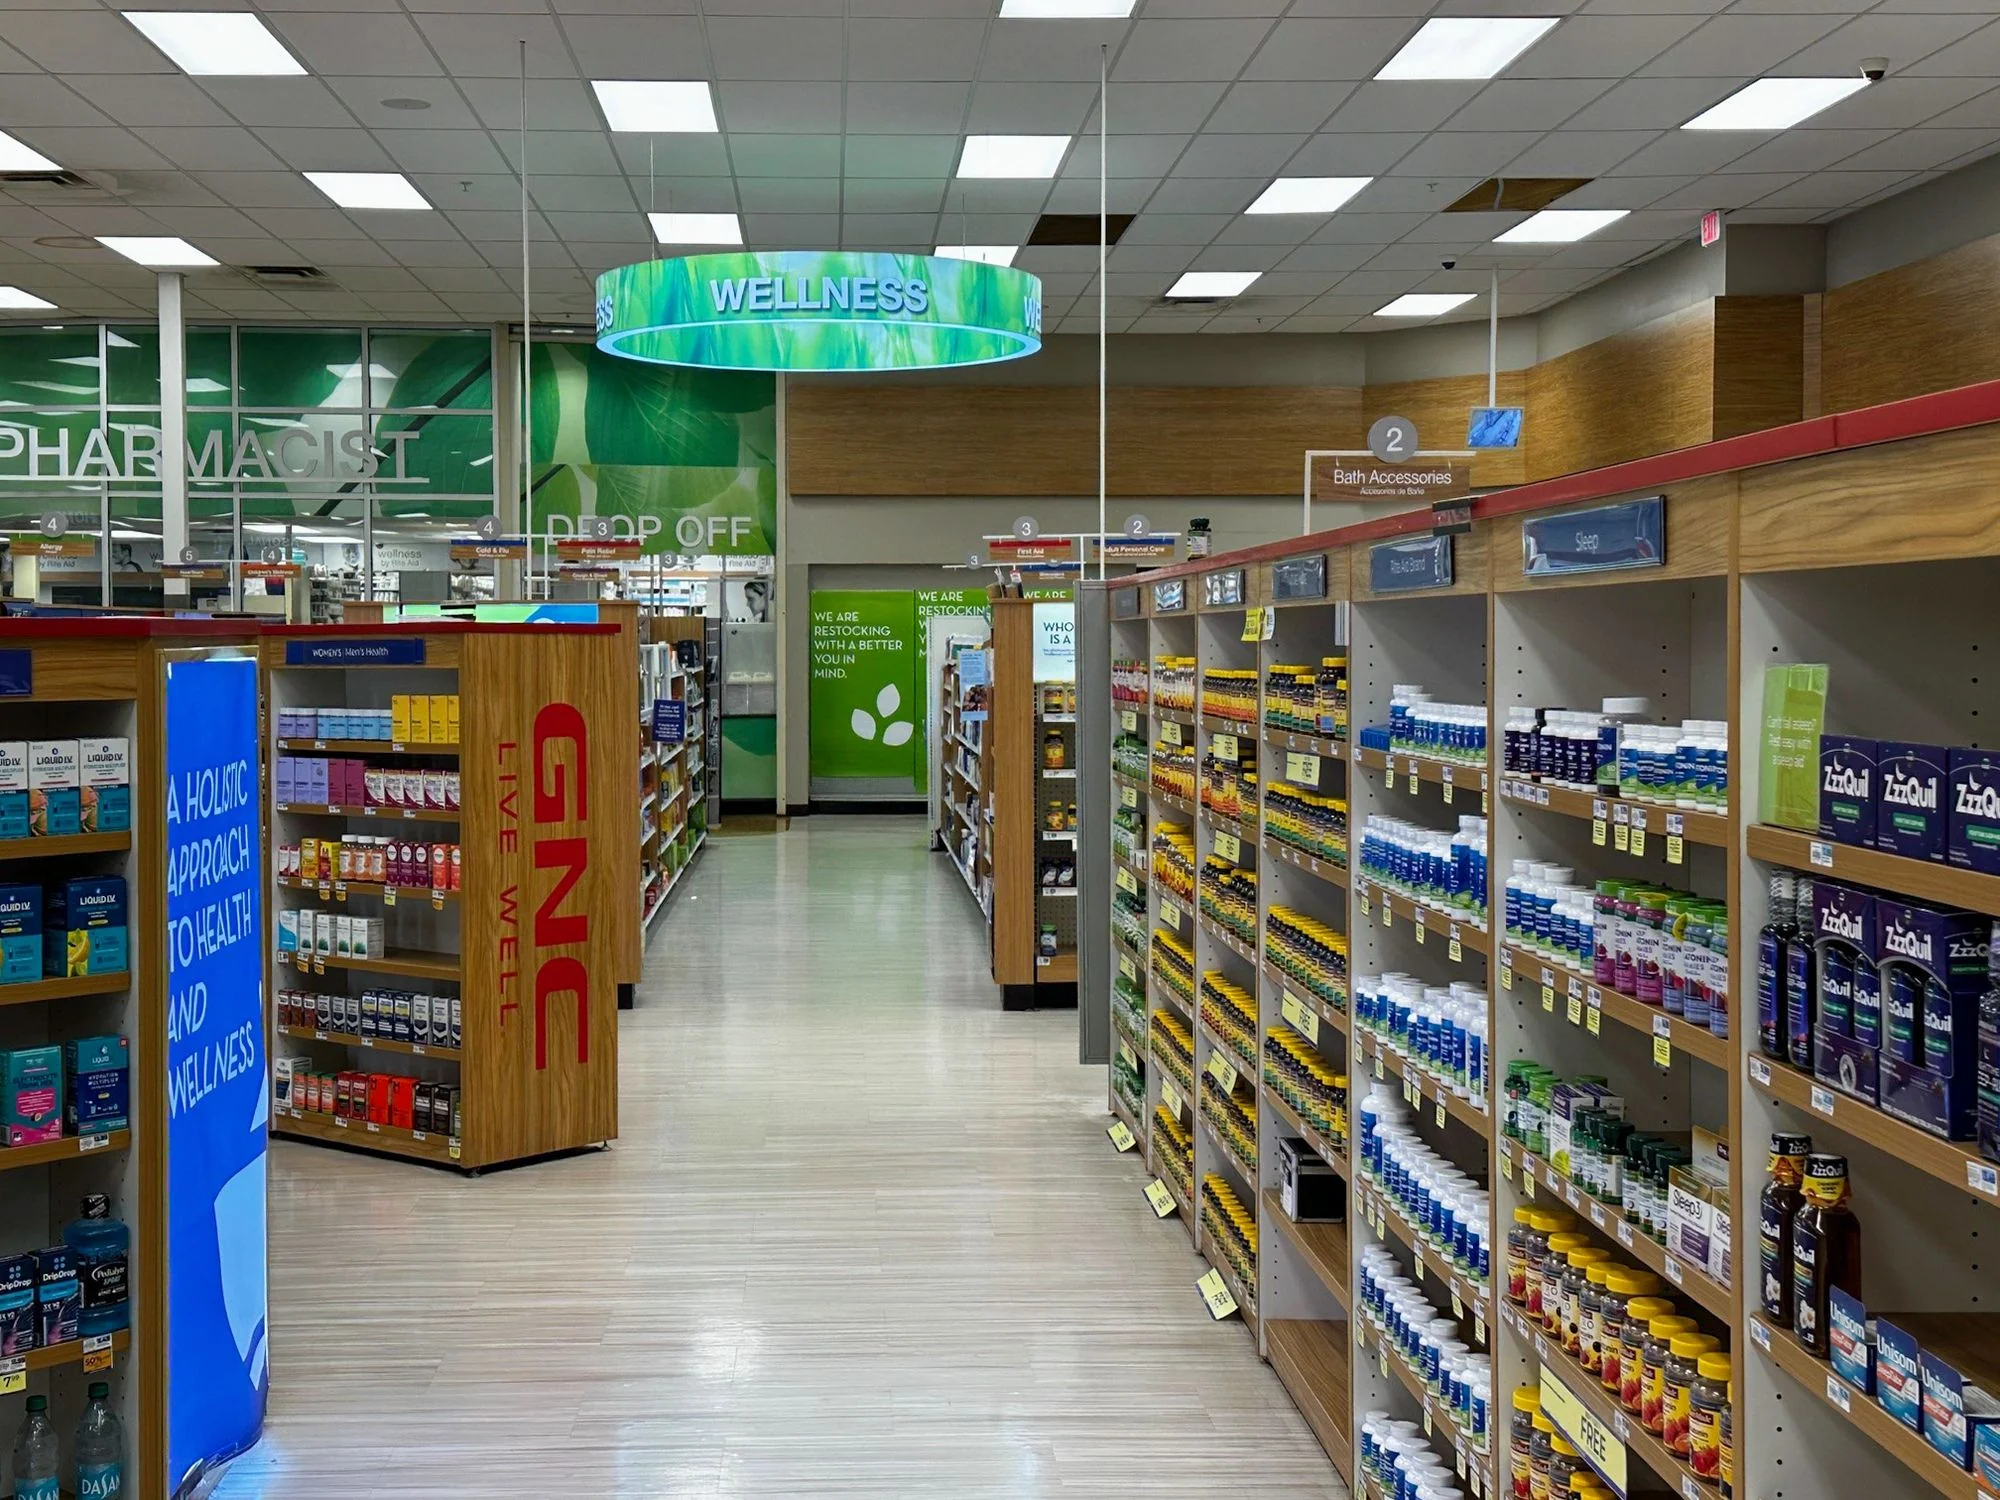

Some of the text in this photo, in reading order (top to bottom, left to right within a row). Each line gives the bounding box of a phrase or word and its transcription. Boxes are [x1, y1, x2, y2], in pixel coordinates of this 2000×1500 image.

[709, 277, 928, 313] WELLNESS
[1386, 427, 1403, 452] 2
[0, 428, 419, 479] PHARMACIST
[1334, 470, 1452, 485] Bath Accessories
[48, 518, 57, 531] 4
[483, 521, 493, 534] 4
[597, 521, 608, 537] 3
[675, 515, 751, 547] OFF
[1022, 522, 1031, 536] 3
[1133, 521, 1142, 534] 2
[1575, 531, 1599, 554] Sleep
[185, 551, 193, 560] 5
[268, 551, 275, 560] 4
[664, 554, 673, 565] 3
[970, 556, 978, 565] 3
[919, 591, 964, 601] WE ARE
[815, 612, 860, 622] WE ARE
[919, 605, 985, 616] RESTOCKIN
[815, 626, 890, 637] RESTOCKING
[1043, 622, 1075, 632] WHO
[814, 640, 903, 650] WITH A BETTER
[1050, 634, 1071, 644] IS A
[312, 648, 341, 657] WOMEN'S
[365, 647, 388, 656] Health
[815, 654, 855, 665] YOU IN
[814, 668, 847, 679] MIND.
[36, 756, 61, 765] LIQUID
[88, 754, 113, 762] LIQUID
[1824, 765, 1869, 798] ZzzQuil
[167, 759, 248, 824] A HOLISTIC
[499, 742, 518, 854] LIVE
[1884, 774, 1937, 809] ZzzQuil
[167, 824, 250, 897] APPROACH
[533, 703, 588, 1070] GNC
[80, 894, 107, 905] LIQUID
[168, 888, 252, 973] TO HEALTH
[1821, 908, 1863, 940] ZzzQuil
[1885, 926, 1932, 962] ZzzQuil
[168, 982, 207, 1043] AND
[168, 1021, 255, 1119] WELLNESS
[1812, 1161, 1844, 1177] ZzzQuil
[43, 1268, 77, 1281] DripDrop
[1830, 1301, 1865, 1340] Unisom
[1877, 1333, 1917, 1375] Unisom
[1921, 1366, 1964, 1411] Unisom
[1580, 1415, 1606, 1461] FREE
